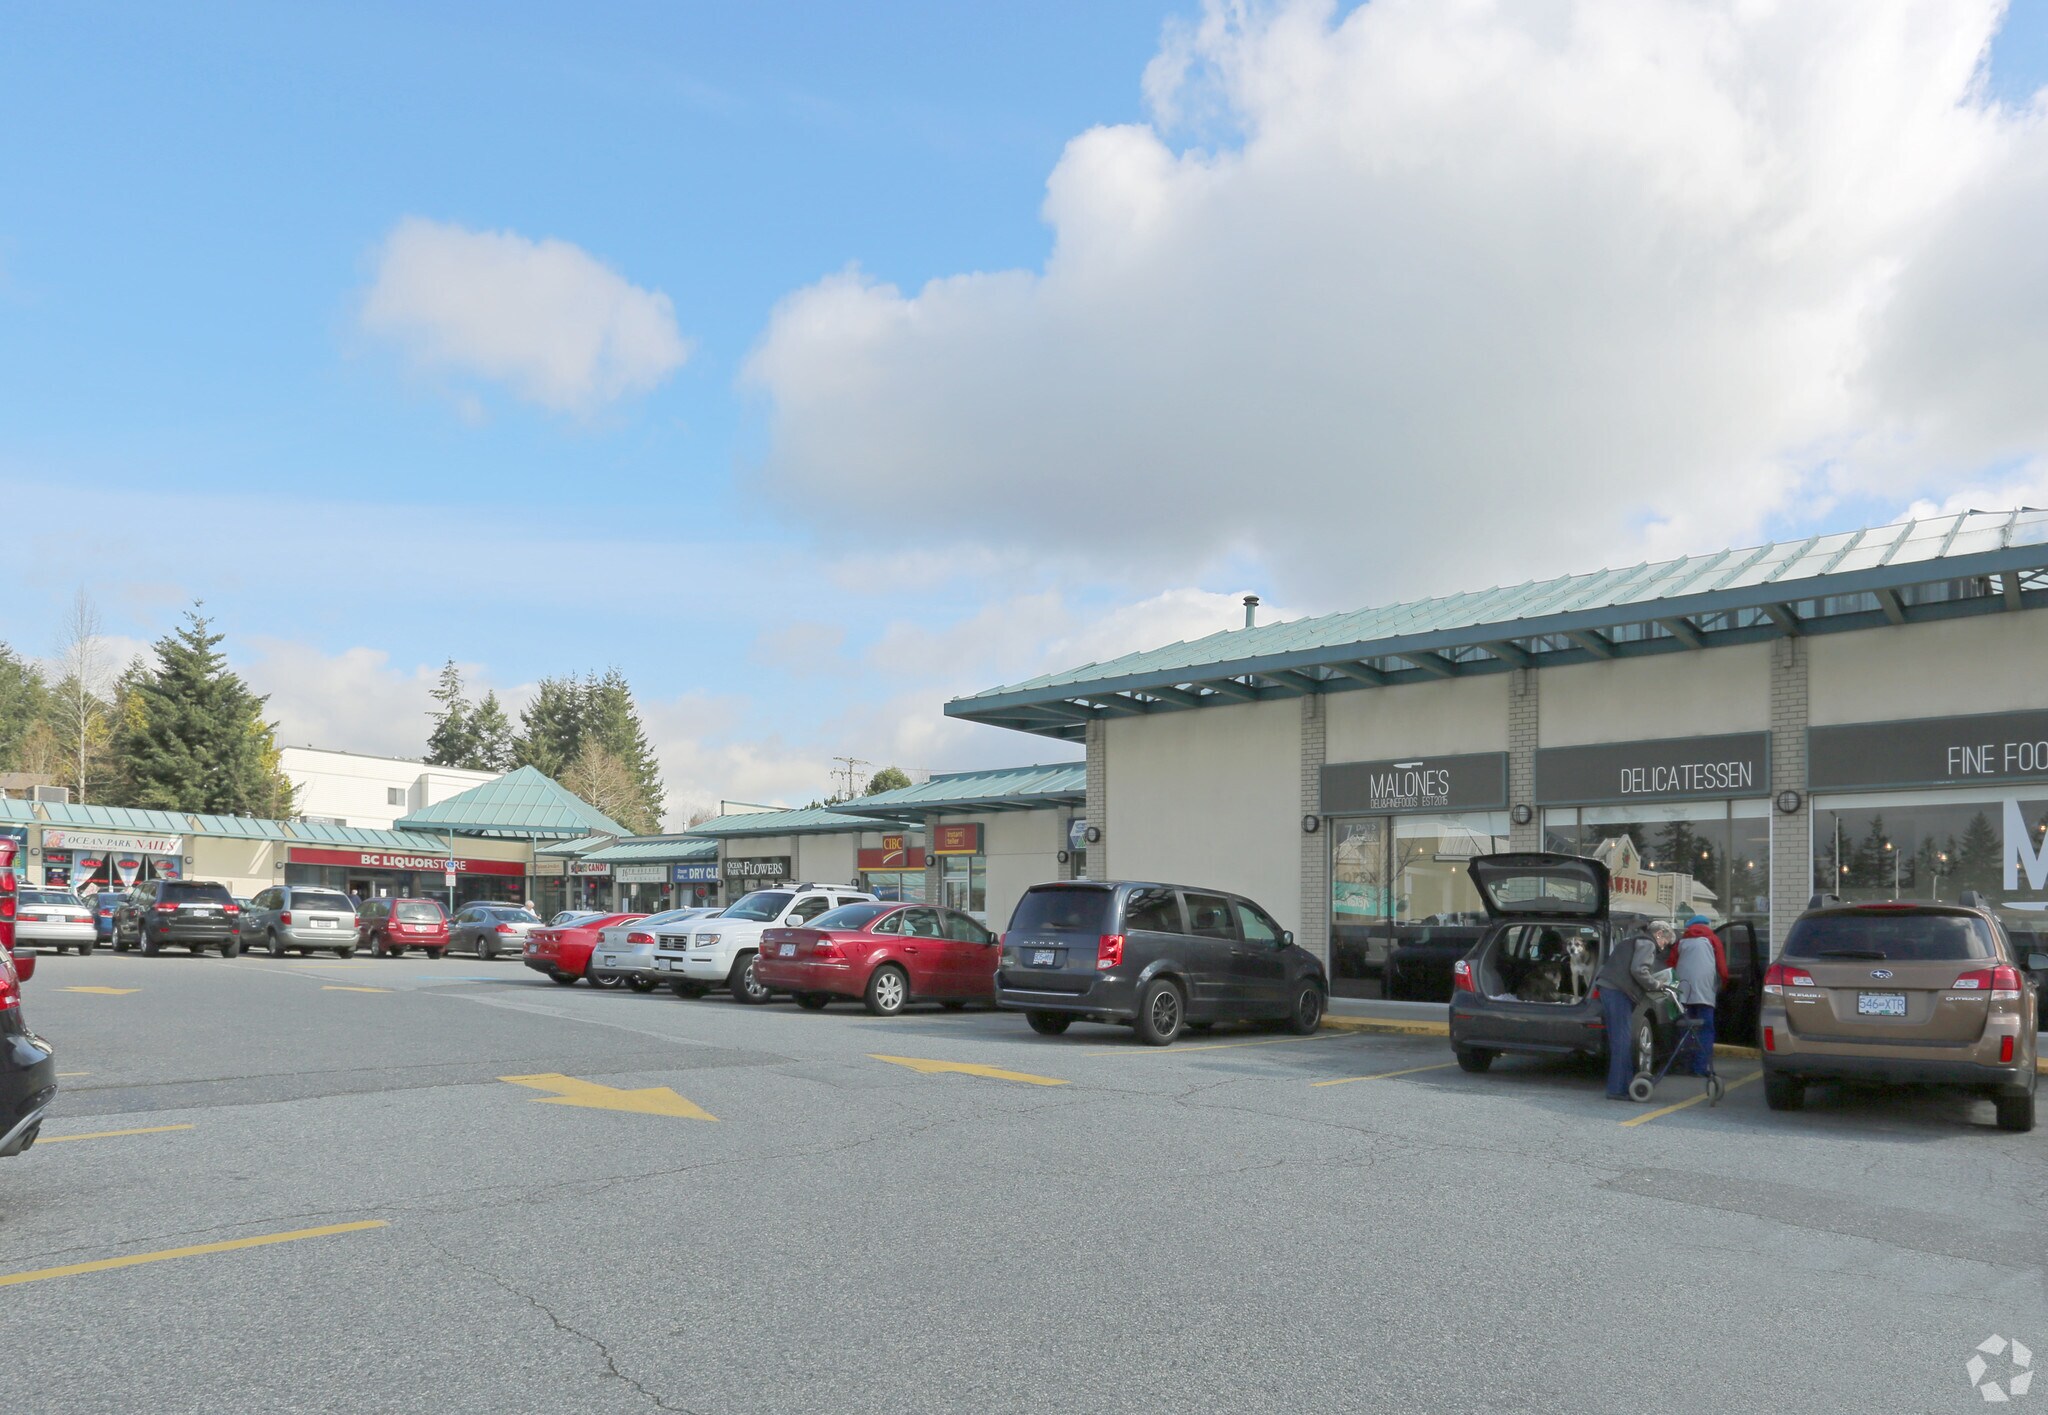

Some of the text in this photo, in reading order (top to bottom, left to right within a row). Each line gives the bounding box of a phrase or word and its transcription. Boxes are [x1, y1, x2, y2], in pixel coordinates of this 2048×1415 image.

[1948, 745, 1995, 775] FINE
[1370, 769, 1449, 799] MALONE'S
[1621, 761, 1752, 794] DELICATESSEN
[68, 836, 103, 846] OCEAN
[106, 839, 132, 848] PARK
[135, 840, 176, 851] NAILS
[883, 838, 903, 850] CIBC
[361, 854, 380, 865] BC
[727, 861, 743, 869] OCEAN
[588, 863, 607, 872] CANDY
[689, 867, 705, 880] DRY
[744, 861, 783, 876] FLOWERS
[1859, 997, 1879, 1009] 546
